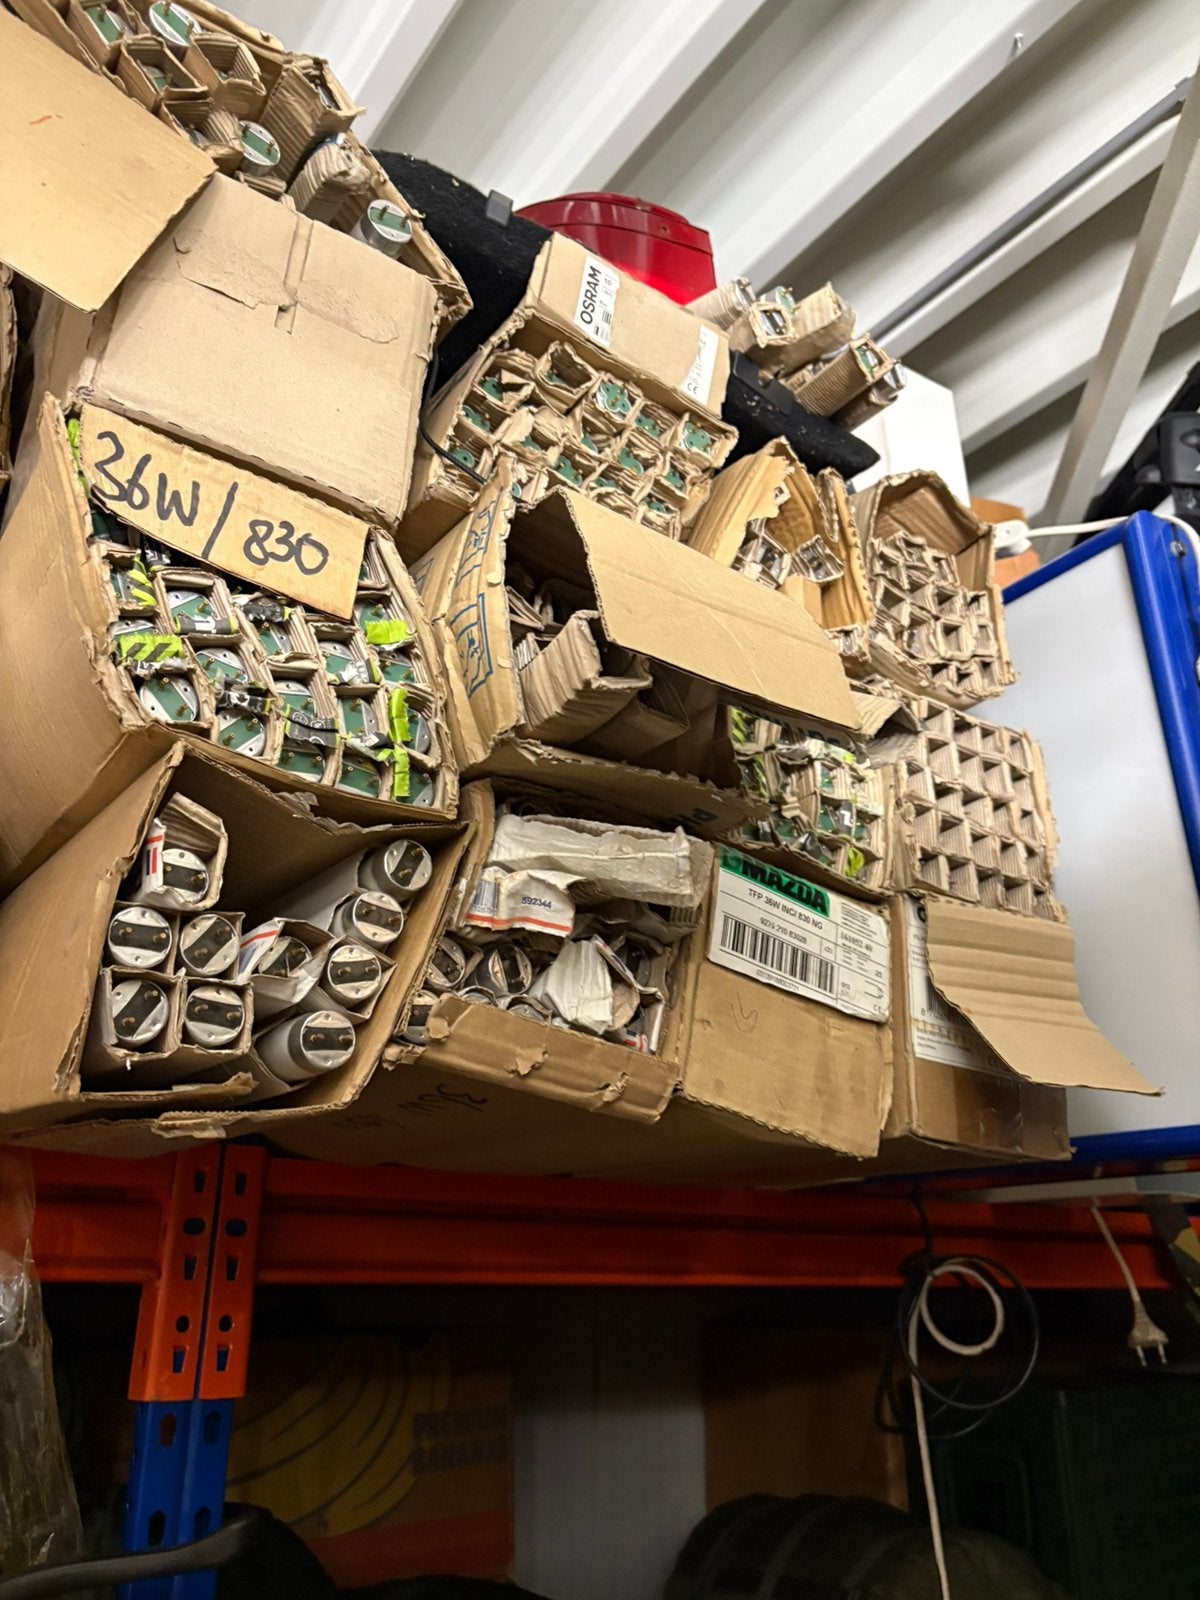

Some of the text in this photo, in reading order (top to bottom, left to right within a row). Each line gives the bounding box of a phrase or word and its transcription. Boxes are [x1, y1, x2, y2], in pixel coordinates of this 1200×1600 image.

[580, 265, 602, 325] OSRAM
[242, 518, 330, 576] 830
[520, 896, 552, 909] 592344
[742, 857, 830, 917] MAZDA
